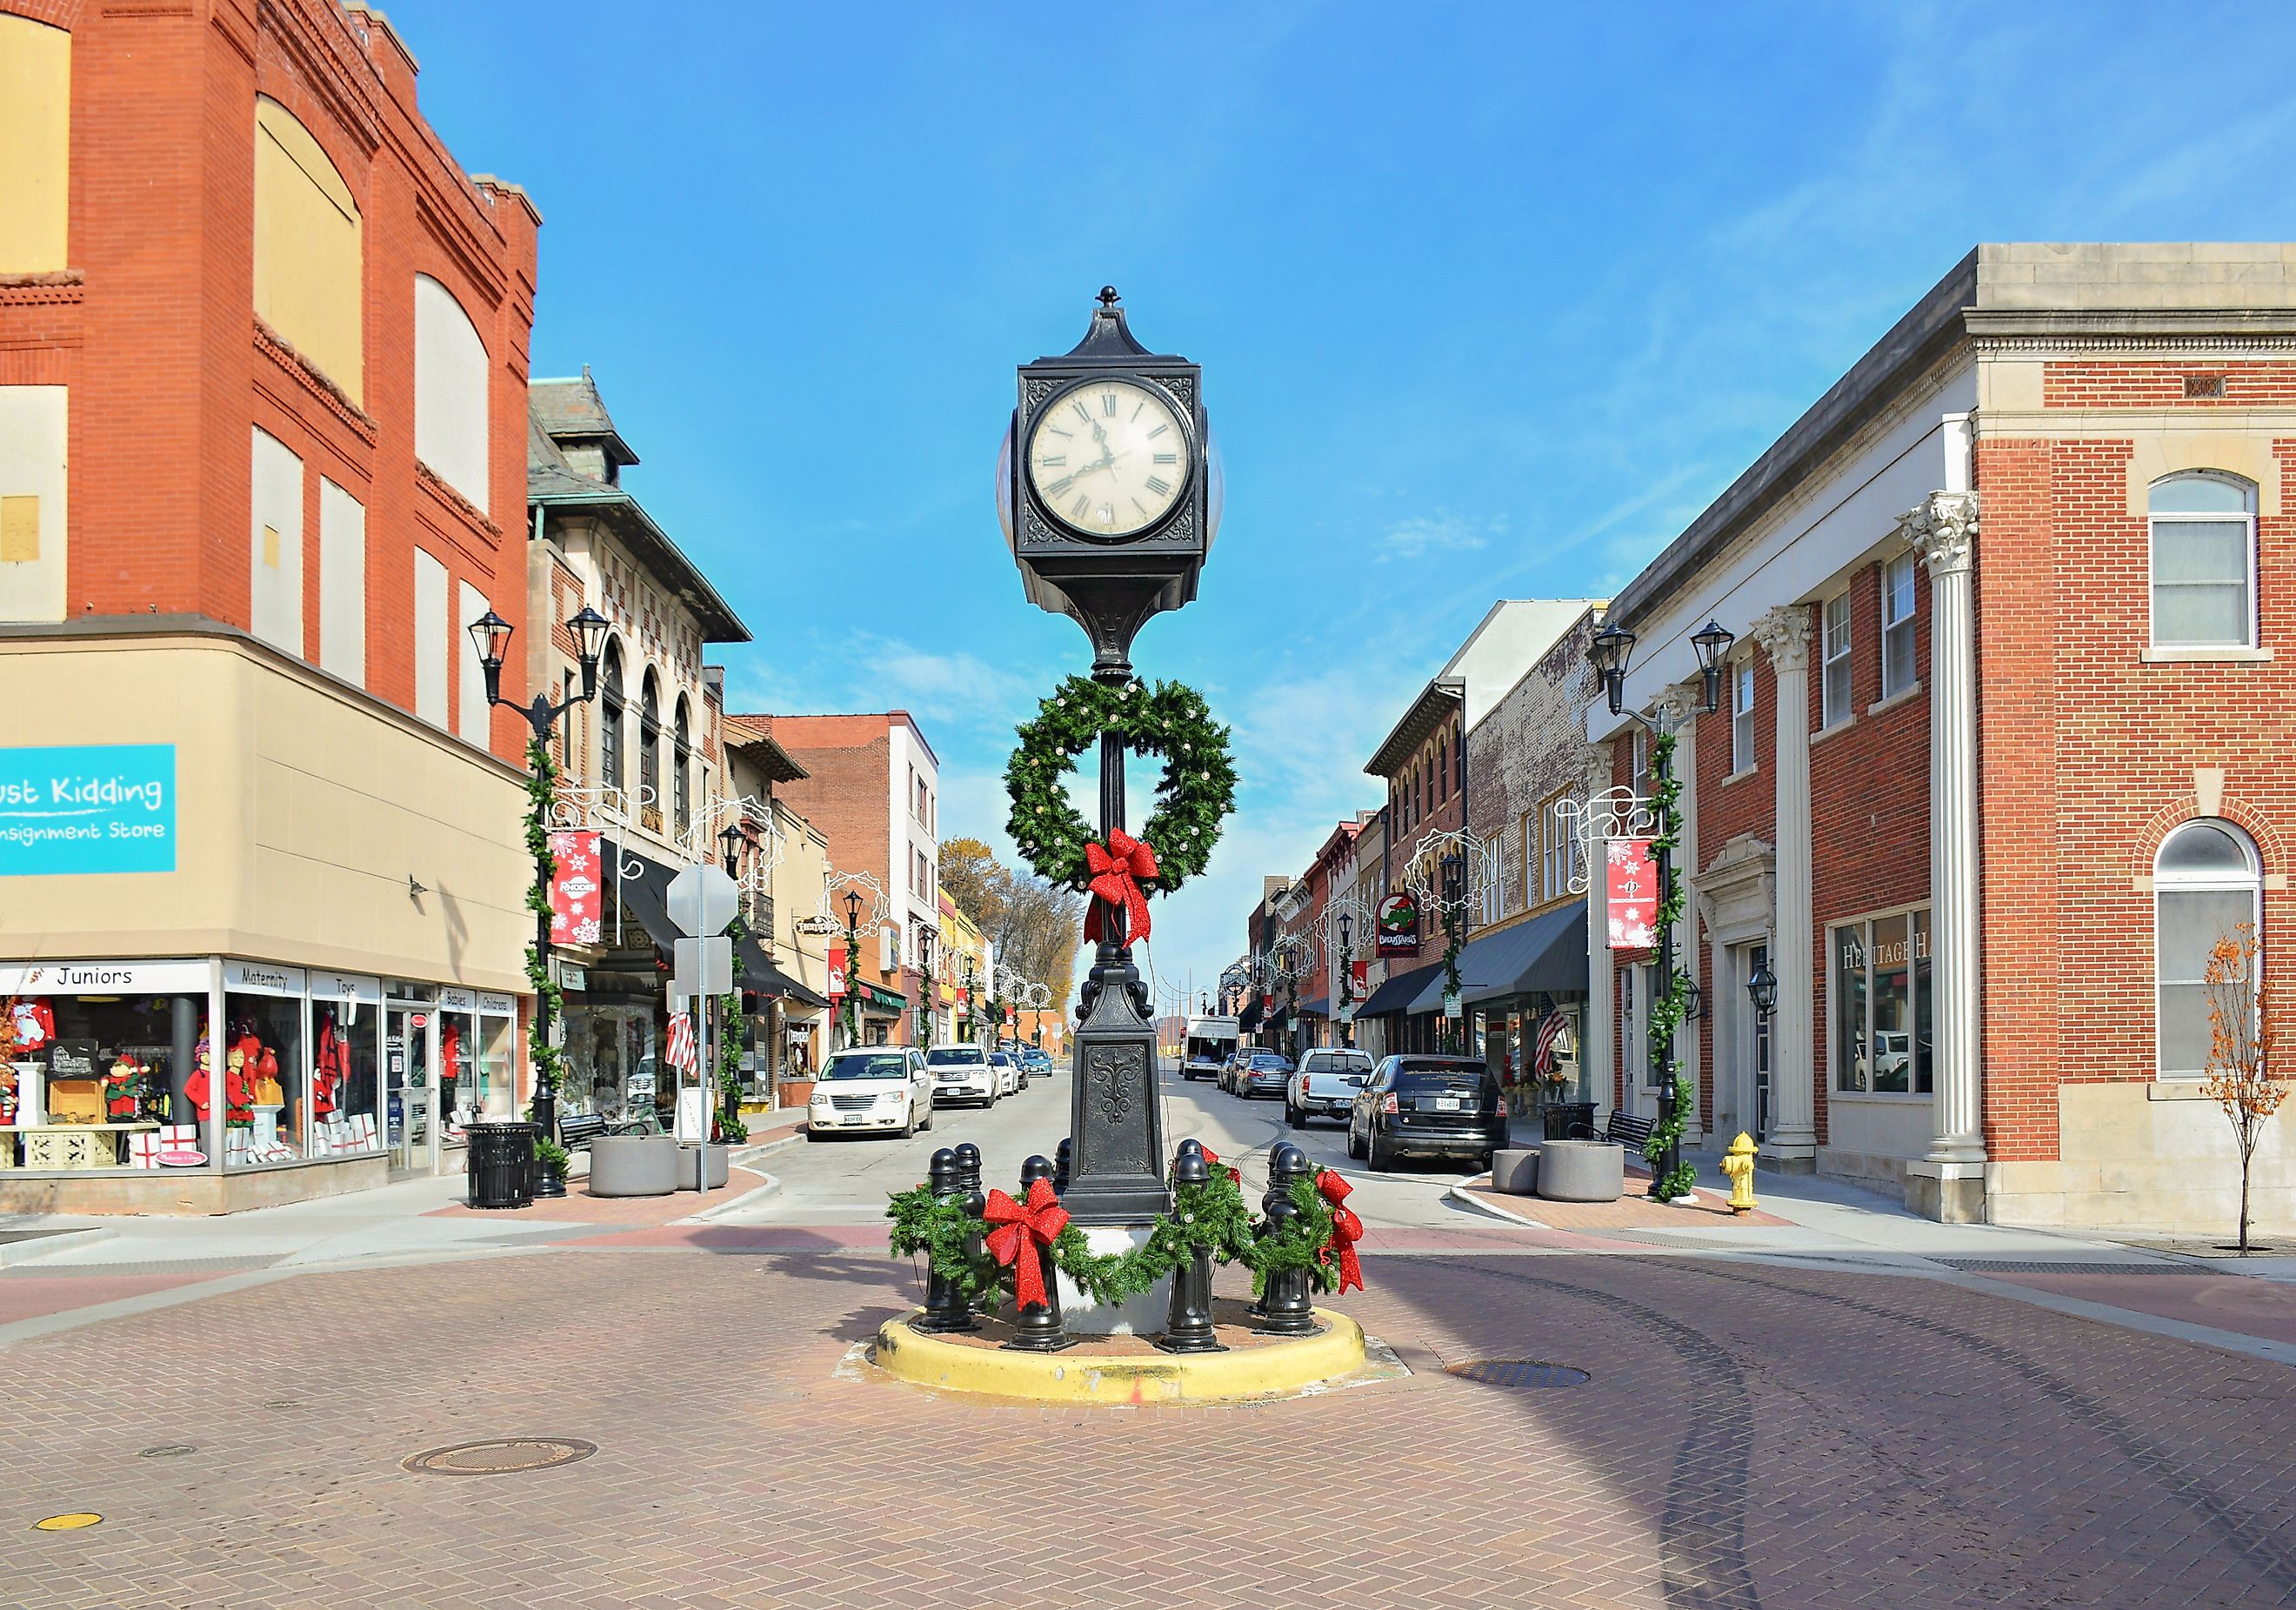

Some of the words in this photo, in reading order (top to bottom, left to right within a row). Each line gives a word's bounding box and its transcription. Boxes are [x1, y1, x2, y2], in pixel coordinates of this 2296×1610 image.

[51, 775, 163, 811] Kidding
[109, 821, 166, 838] Store
[1914, 931, 1932, 959] H
[57, 967, 132, 985] Juniors
[242, 967, 288, 993] Maternity
[336, 978, 355, 997] Toys
